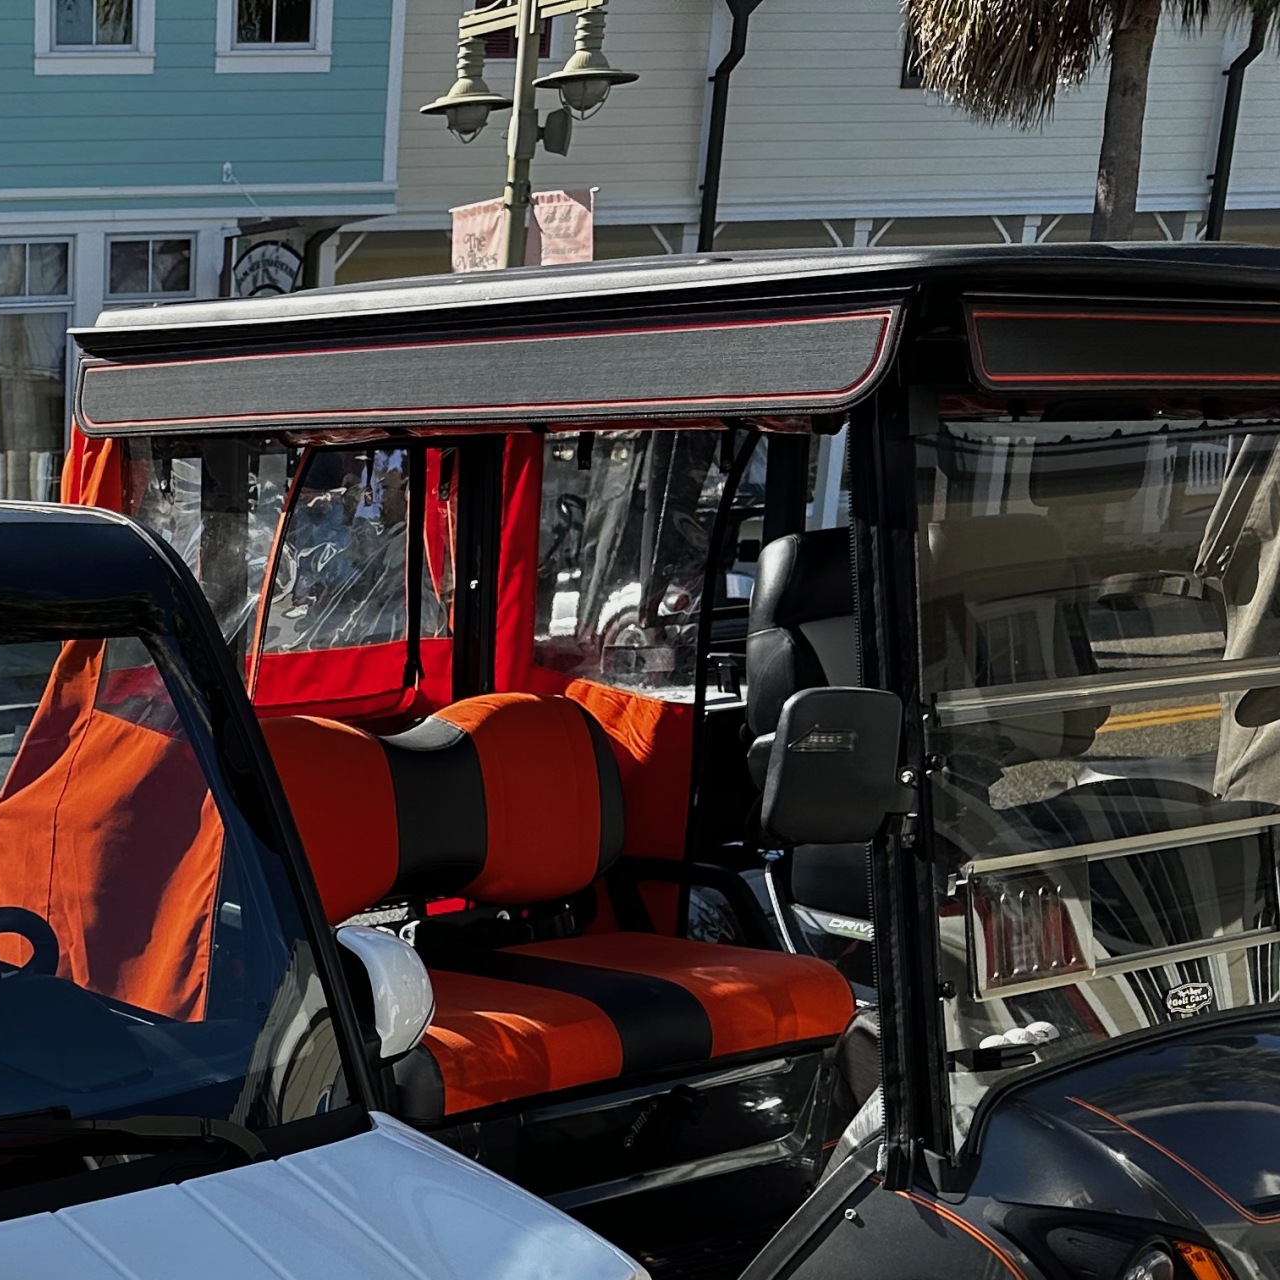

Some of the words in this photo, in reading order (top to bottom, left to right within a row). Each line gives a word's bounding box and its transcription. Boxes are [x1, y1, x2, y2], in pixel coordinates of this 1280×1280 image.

[463, 233, 487, 251] The
[455, 250, 499, 270] Villages
[828, 918, 875, 935] DRIV
